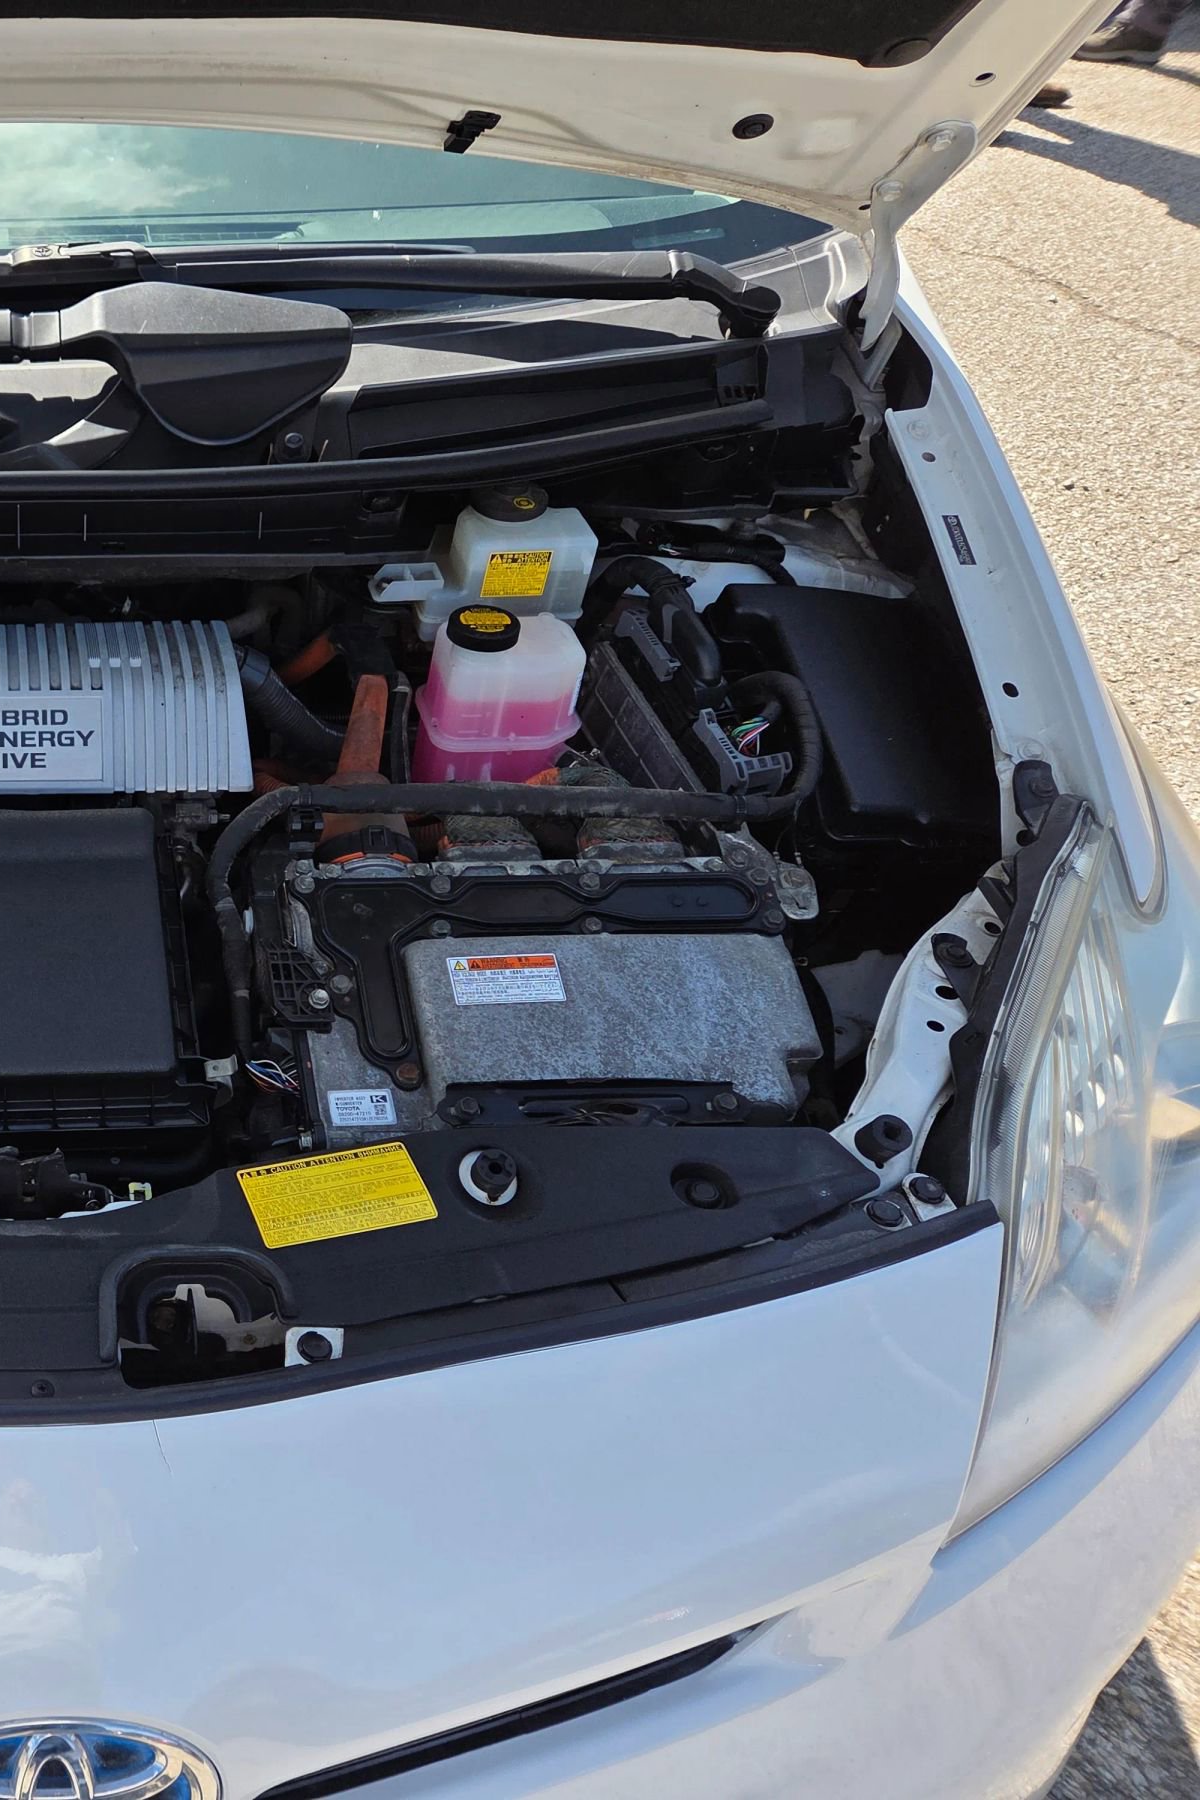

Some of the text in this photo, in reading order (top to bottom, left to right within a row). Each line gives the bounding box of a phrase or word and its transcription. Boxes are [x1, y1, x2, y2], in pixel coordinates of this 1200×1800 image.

[357, 1145, 401, 1158] ВНИМАНИЕ
[270, 1161, 307, 1174] CAUTION
[310, 1152, 356, 1167] ATTENTION
